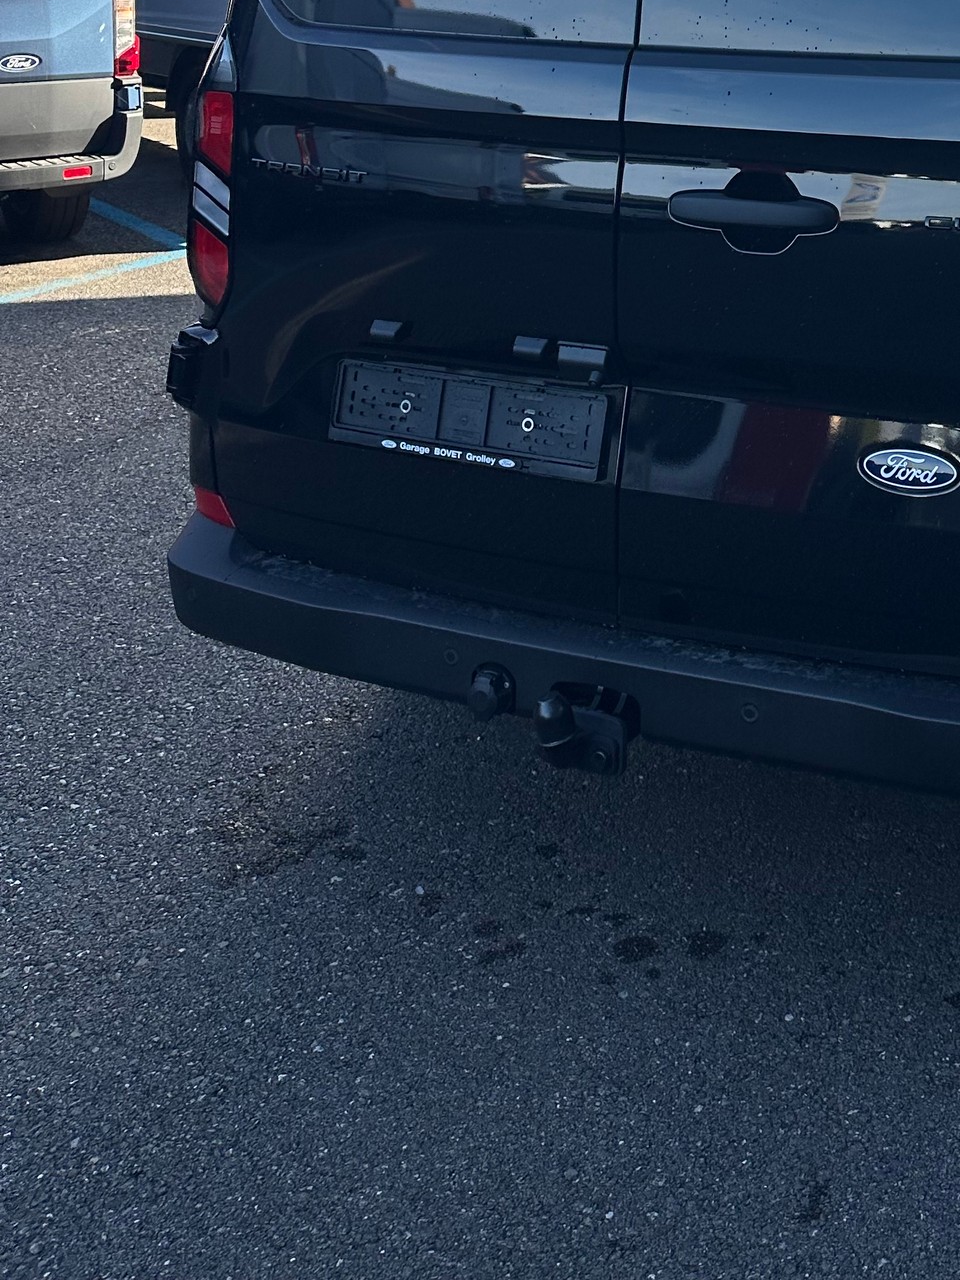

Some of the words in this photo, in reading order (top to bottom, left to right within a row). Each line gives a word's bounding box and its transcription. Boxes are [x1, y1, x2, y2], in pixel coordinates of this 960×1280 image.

[7, 57, 32, 69] Ford
[251, 157, 370, 183] TRANSIT
[399, 441, 430, 455] Garage
[434, 447, 463, 460] BOVET
[466, 452, 496, 466] Grolley
[880, 454, 939, 484] Ford
